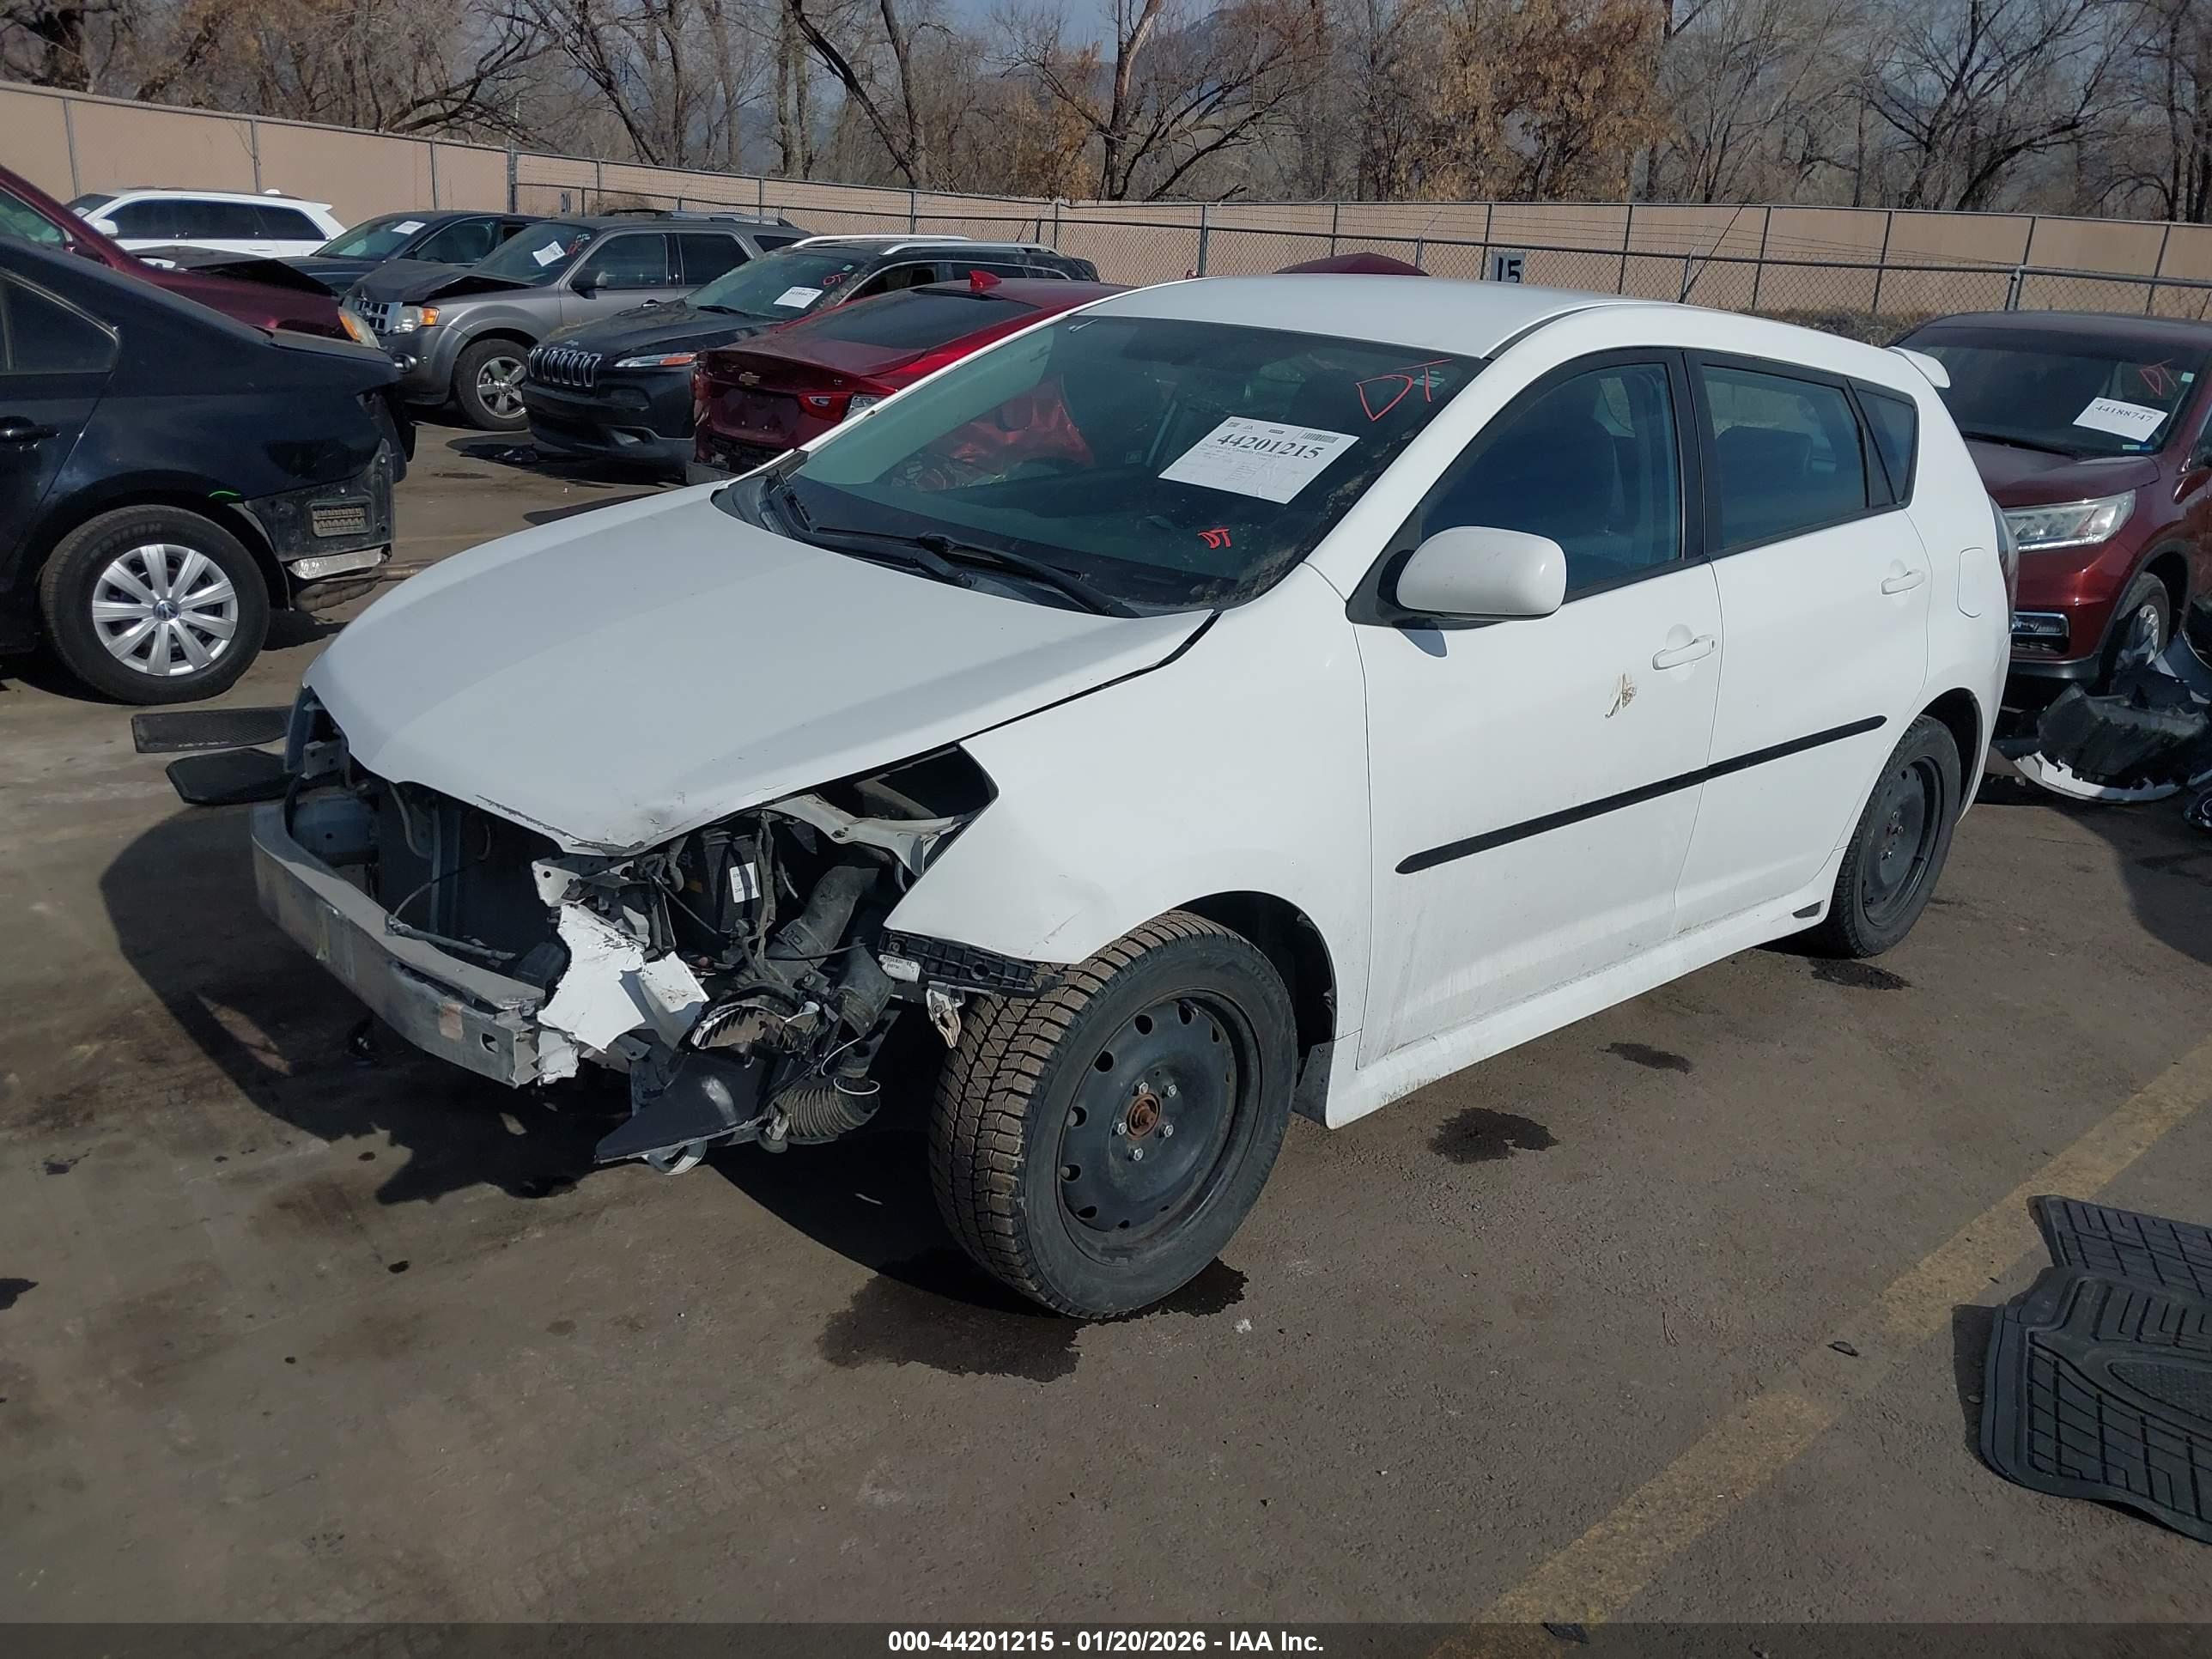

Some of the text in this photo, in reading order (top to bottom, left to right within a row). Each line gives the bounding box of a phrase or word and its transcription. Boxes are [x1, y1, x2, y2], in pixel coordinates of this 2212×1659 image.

[1497, 257, 1522, 283] 15
[1355, 358, 1453, 421] DT
[2095, 404, 2153, 422] 44188747
[1217, 433, 1325, 459] 44201215
[1197, 528, 1231, 549] DT
